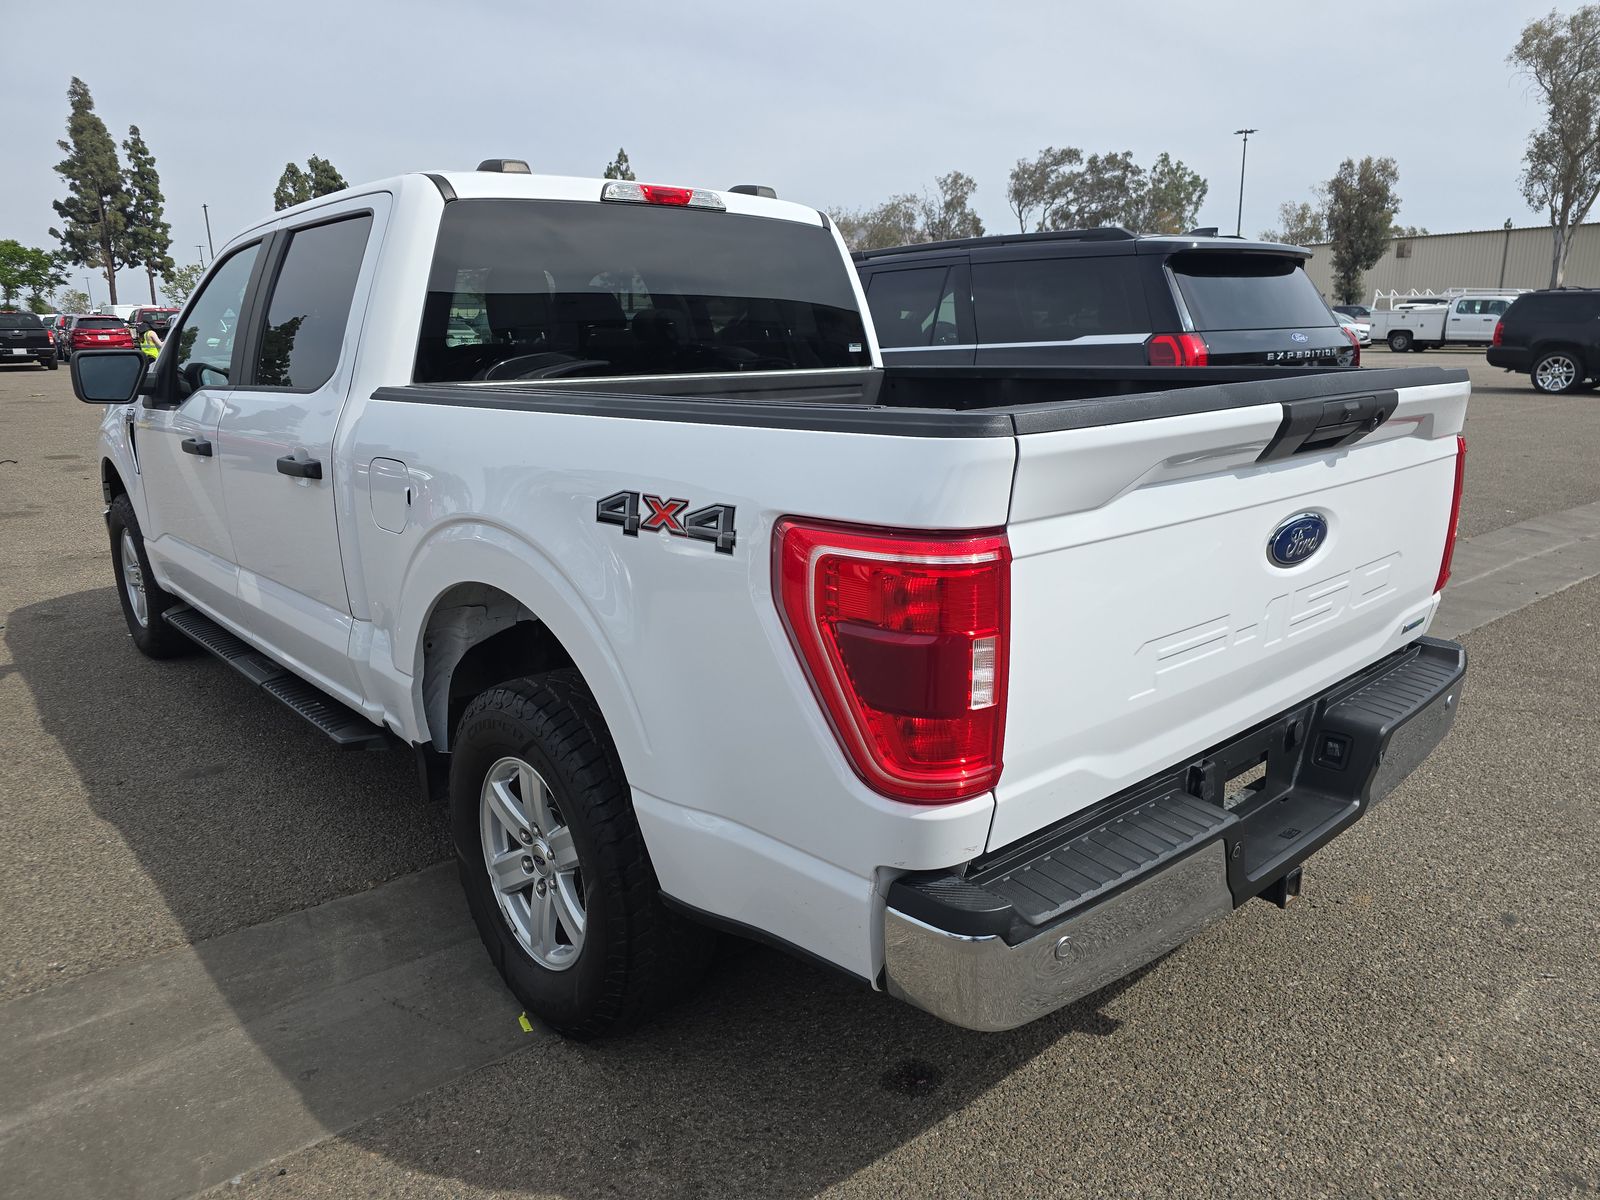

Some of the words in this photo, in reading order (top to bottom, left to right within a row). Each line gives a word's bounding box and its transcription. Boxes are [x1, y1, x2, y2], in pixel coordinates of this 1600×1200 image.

[1267, 347, 1338, 361] EXPEDITION
[1285, 524, 1321, 559] Ford
[1128, 550, 1402, 701] F-150
